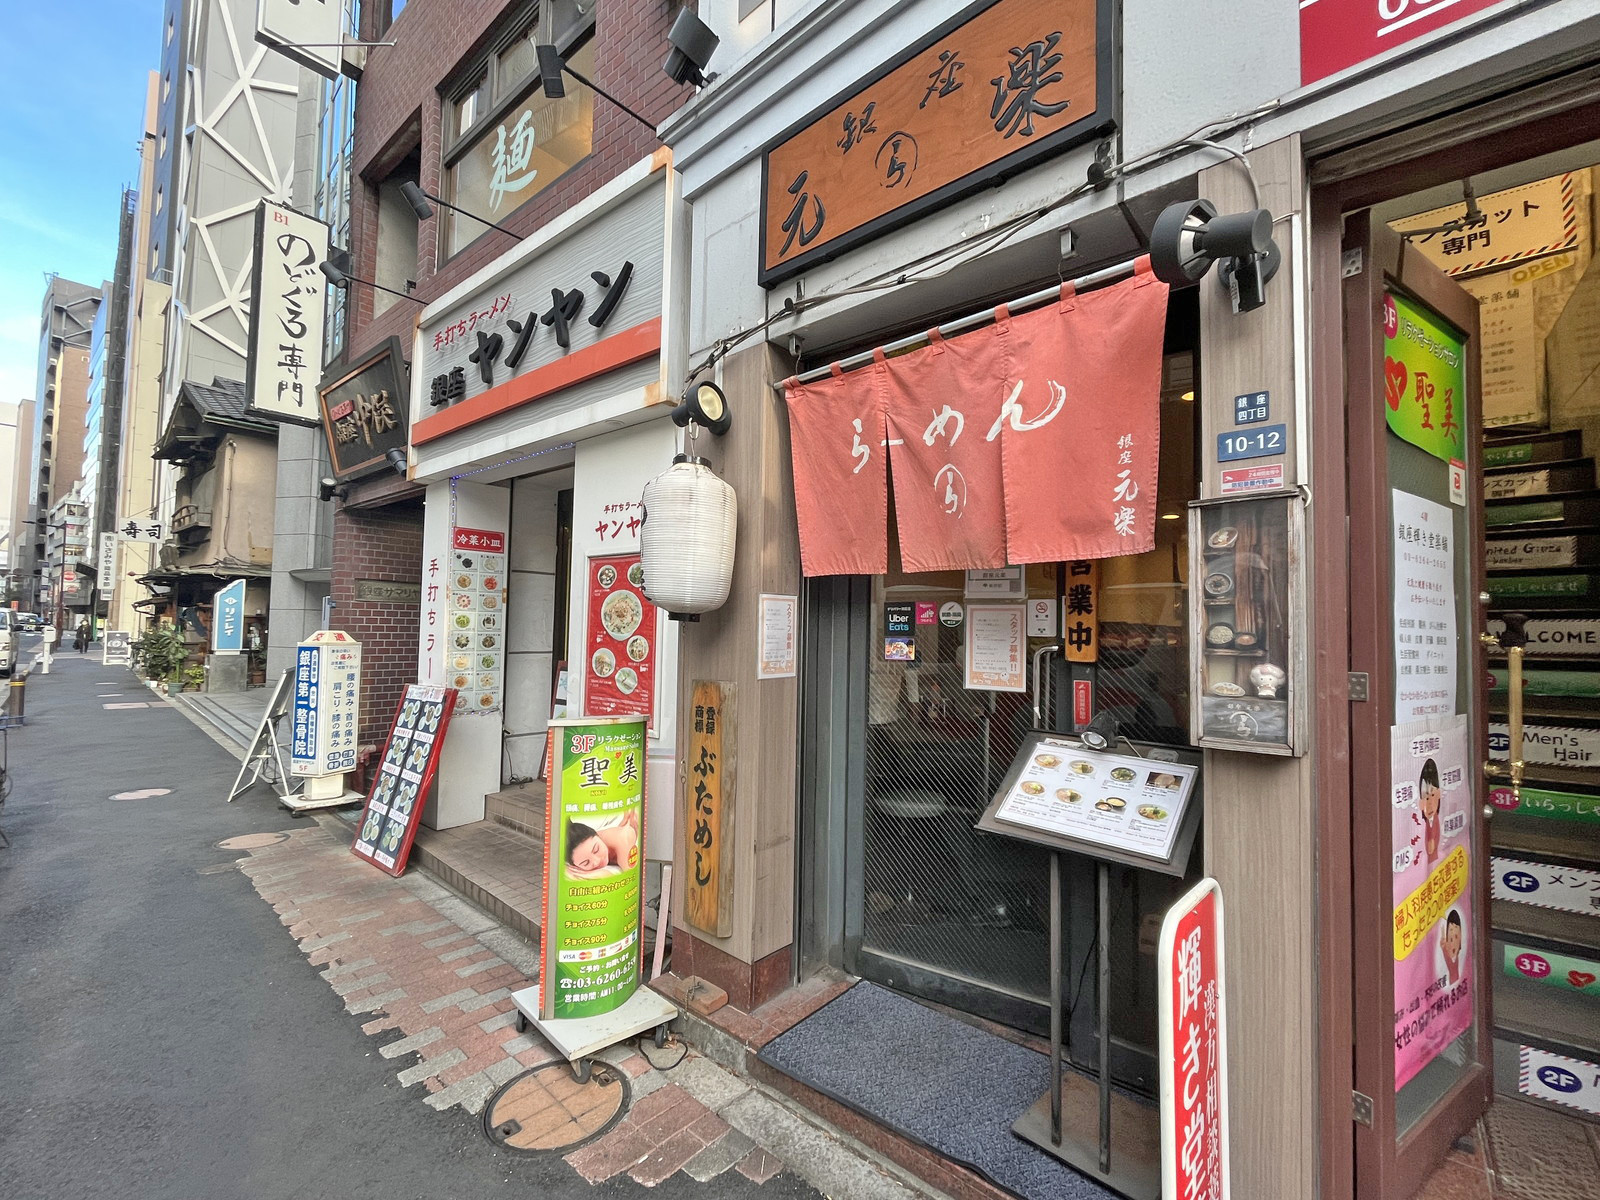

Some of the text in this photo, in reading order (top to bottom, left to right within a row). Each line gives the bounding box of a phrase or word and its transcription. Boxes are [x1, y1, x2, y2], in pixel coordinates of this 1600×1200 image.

[489, 110, 538, 213] 麺
[273, 211, 290, 226] B1
[779, 170, 826, 258] 元
[1441, 229, 1491, 256] 専門
[1511, 253, 1570, 284] OPEN
[275, 233, 318, 408] のどぐろ専門
[433, 293, 511, 352] 手打ちラーメン
[469, 260, 635, 385] ヤンヤン
[430, 365, 466, 407] 銀座
[1238, 394, 1266, 408] 銀座
[1413, 371, 1459, 446] 聖美
[1238, 407, 1266, 421] 四丁目
[850, 379, 1067, 475] らーめん
[1116, 433, 1135, 466] 銀座
[1225, 431, 1280, 454] 10-12
[595, 515, 641, 542] ヤンヤ
[457, 533, 501, 548] 冷菜小皿
[889, 614, 909, 623] Uber
[889, 623, 909, 631] Eats
[295, 650, 311, 756] 銀座第一整骨院
[571, 732, 642, 753] 3F リラクゼーション
[1489, 738, 1510, 748] 2F
[1522, 732, 1579, 747] Men's
[1553, 747, 1593, 762] Hair
[581, 753, 638, 788] 聖美
[694, 745, 715, 887] ぶためし
[1395, 850, 1410, 870] PMS
[1507, 875, 1534, 889] 2F
[565, 900, 608, 912] チョイス60分
[565, 917, 608, 929] チョイス75分
[564, 934, 607, 947] チョイス90分
[1519, 957, 1547, 974] 3F
[1544, 1070, 1575, 1087] 2F
